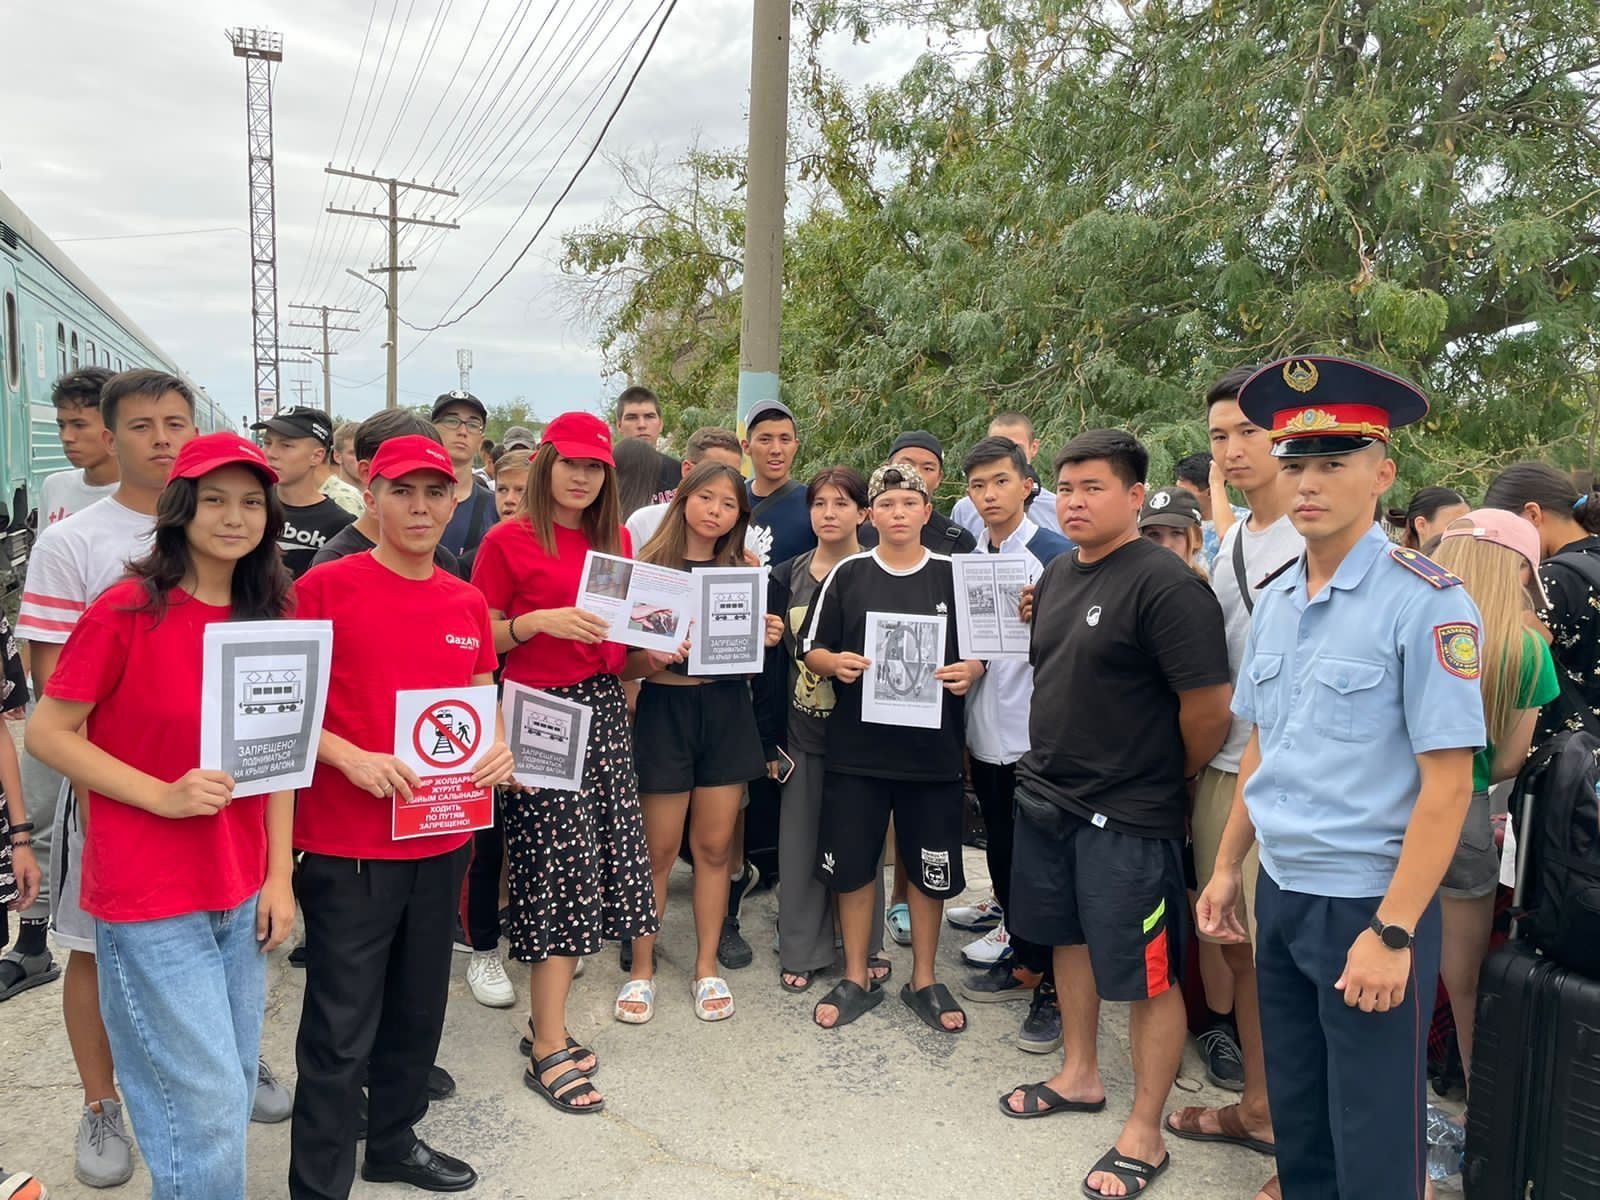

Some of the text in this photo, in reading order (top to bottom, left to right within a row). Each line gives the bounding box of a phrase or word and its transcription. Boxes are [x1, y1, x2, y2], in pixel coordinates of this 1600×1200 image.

[238, 739, 297, 757] ЗАПРЕЩЕНО!
[242, 750, 291, 767] ПОДНИМАТЬСЯ
[234, 760, 295, 778] НА КРЫШУ ВАГОНА
[406, 794, 436, 804] ЫЙЫМ
[430, 803, 462, 813] ХОДИТЬ
[425, 811, 465, 822] ПО ПУТЯМ
[419, 818, 471, 830] ЗАПРЕЩЕНО!
